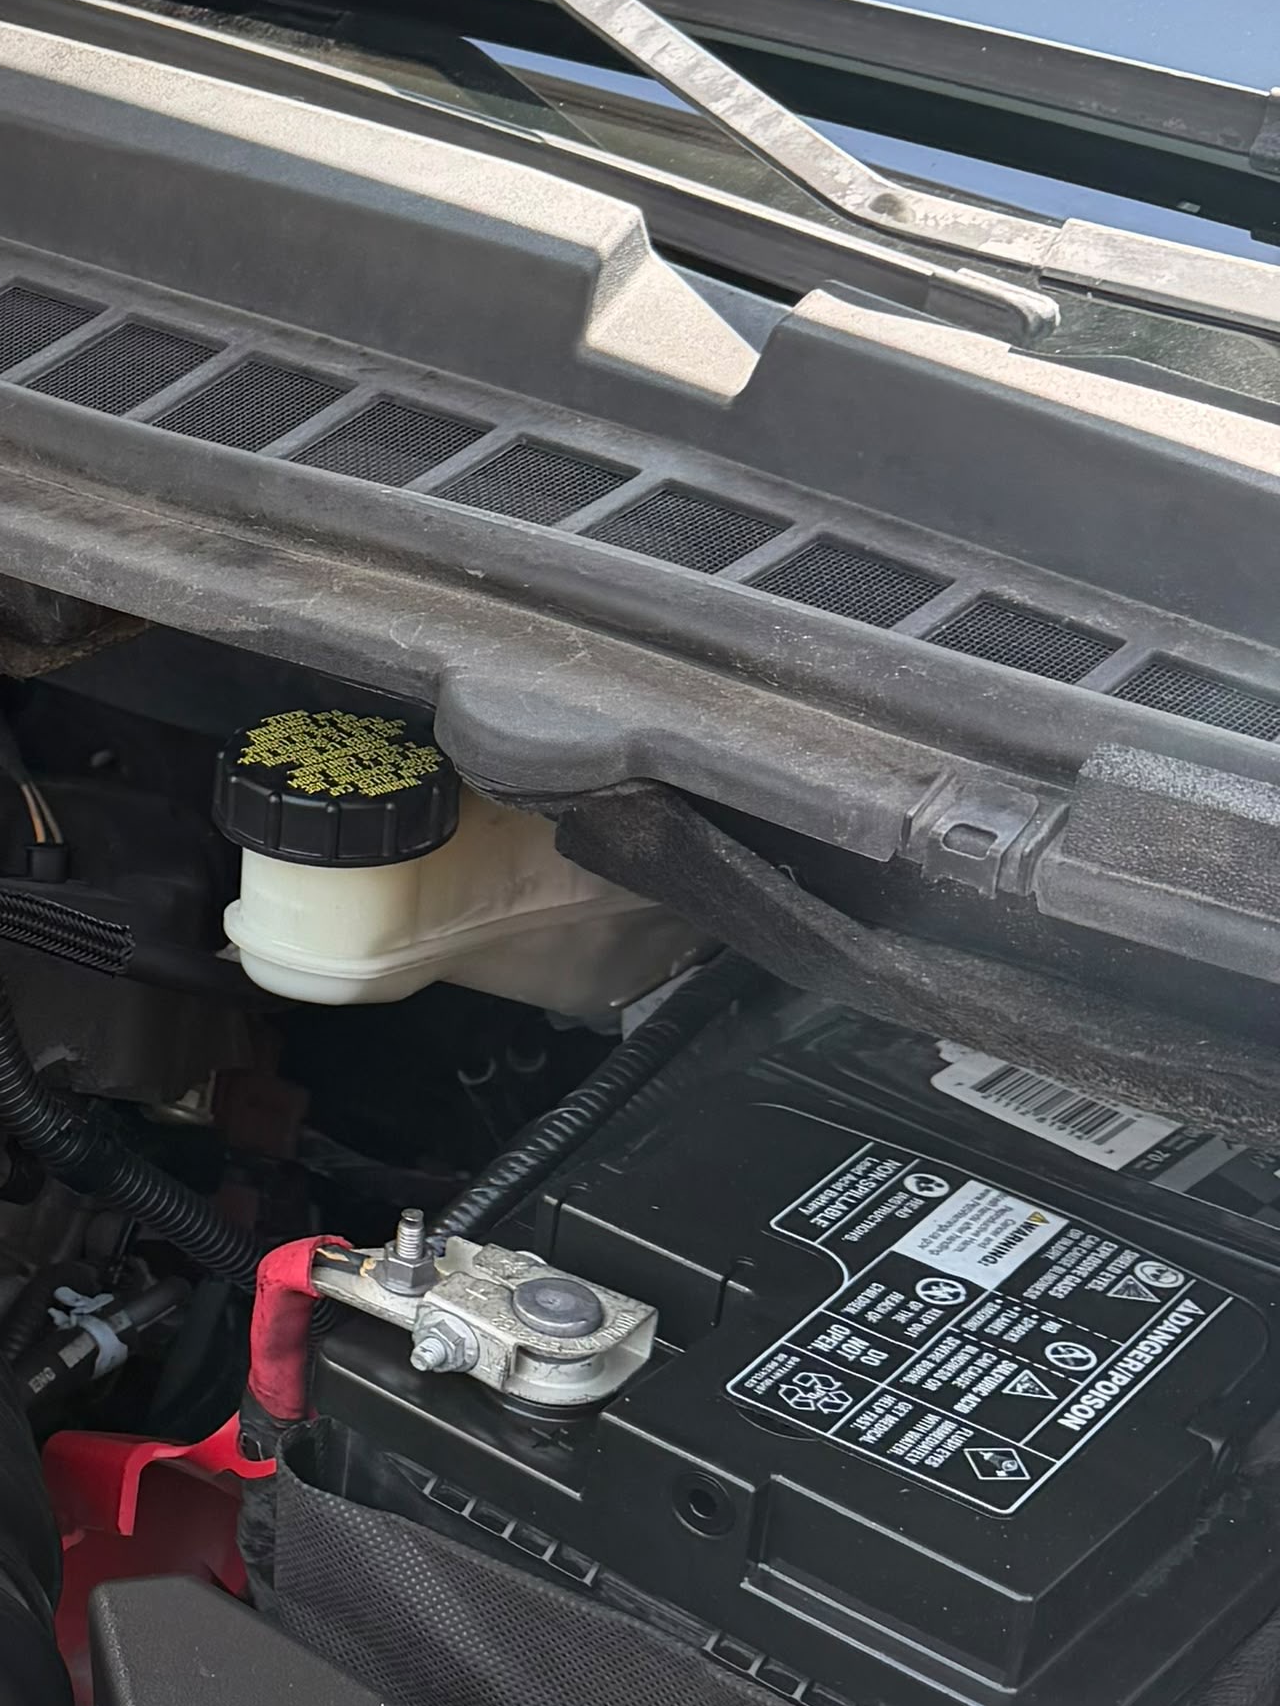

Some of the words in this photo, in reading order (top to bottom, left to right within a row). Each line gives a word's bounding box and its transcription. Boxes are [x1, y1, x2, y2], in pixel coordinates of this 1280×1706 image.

[850, 1157, 879, 1176] Lead
[810, 1159, 902, 1228] NON-SPILLABLE
[830, 1173, 856, 1191] Acid
[798, 1189, 836, 1215] Battery
[895, 1197, 925, 1218] READ
[841, 1191, 909, 1241] INSTRUCTIONS.
[977, 1218, 1040, 1266] WARNING:
[1048, 1275, 1082, 1299] GASES
[1084, 1271, 1117, 1291] EYES.
[807, 1324, 851, 1352] OPEN.
[836, 1336, 870, 1361] NOT
[860, 1349, 889, 1366] DO
[973, 1352, 998, 1369] CAN
[951, 1366, 983, 1389] CAUSE
[972, 1360, 1018, 1396] SULFURIC
[1057, 1312, 1193, 1431] DANGER/POISON
[921, 1378, 943, 1391] OR
[872, 1394, 897, 1414] HELP
[891, 1402, 913, 1417] GET
[953, 1393, 981, 1414] ACID
[850, 1411, 879, 1430] FAST.
[858, 1414, 900, 1444] MEDICAL
[913, 1413, 942, 1434] WITH
[886, 1430, 924, 1455] WATER.
[904, 1420, 958, 1465] IMMEDIATELY
[941, 1427, 974, 1451] FLUSH
[924, 1448, 952, 1468] EYES
